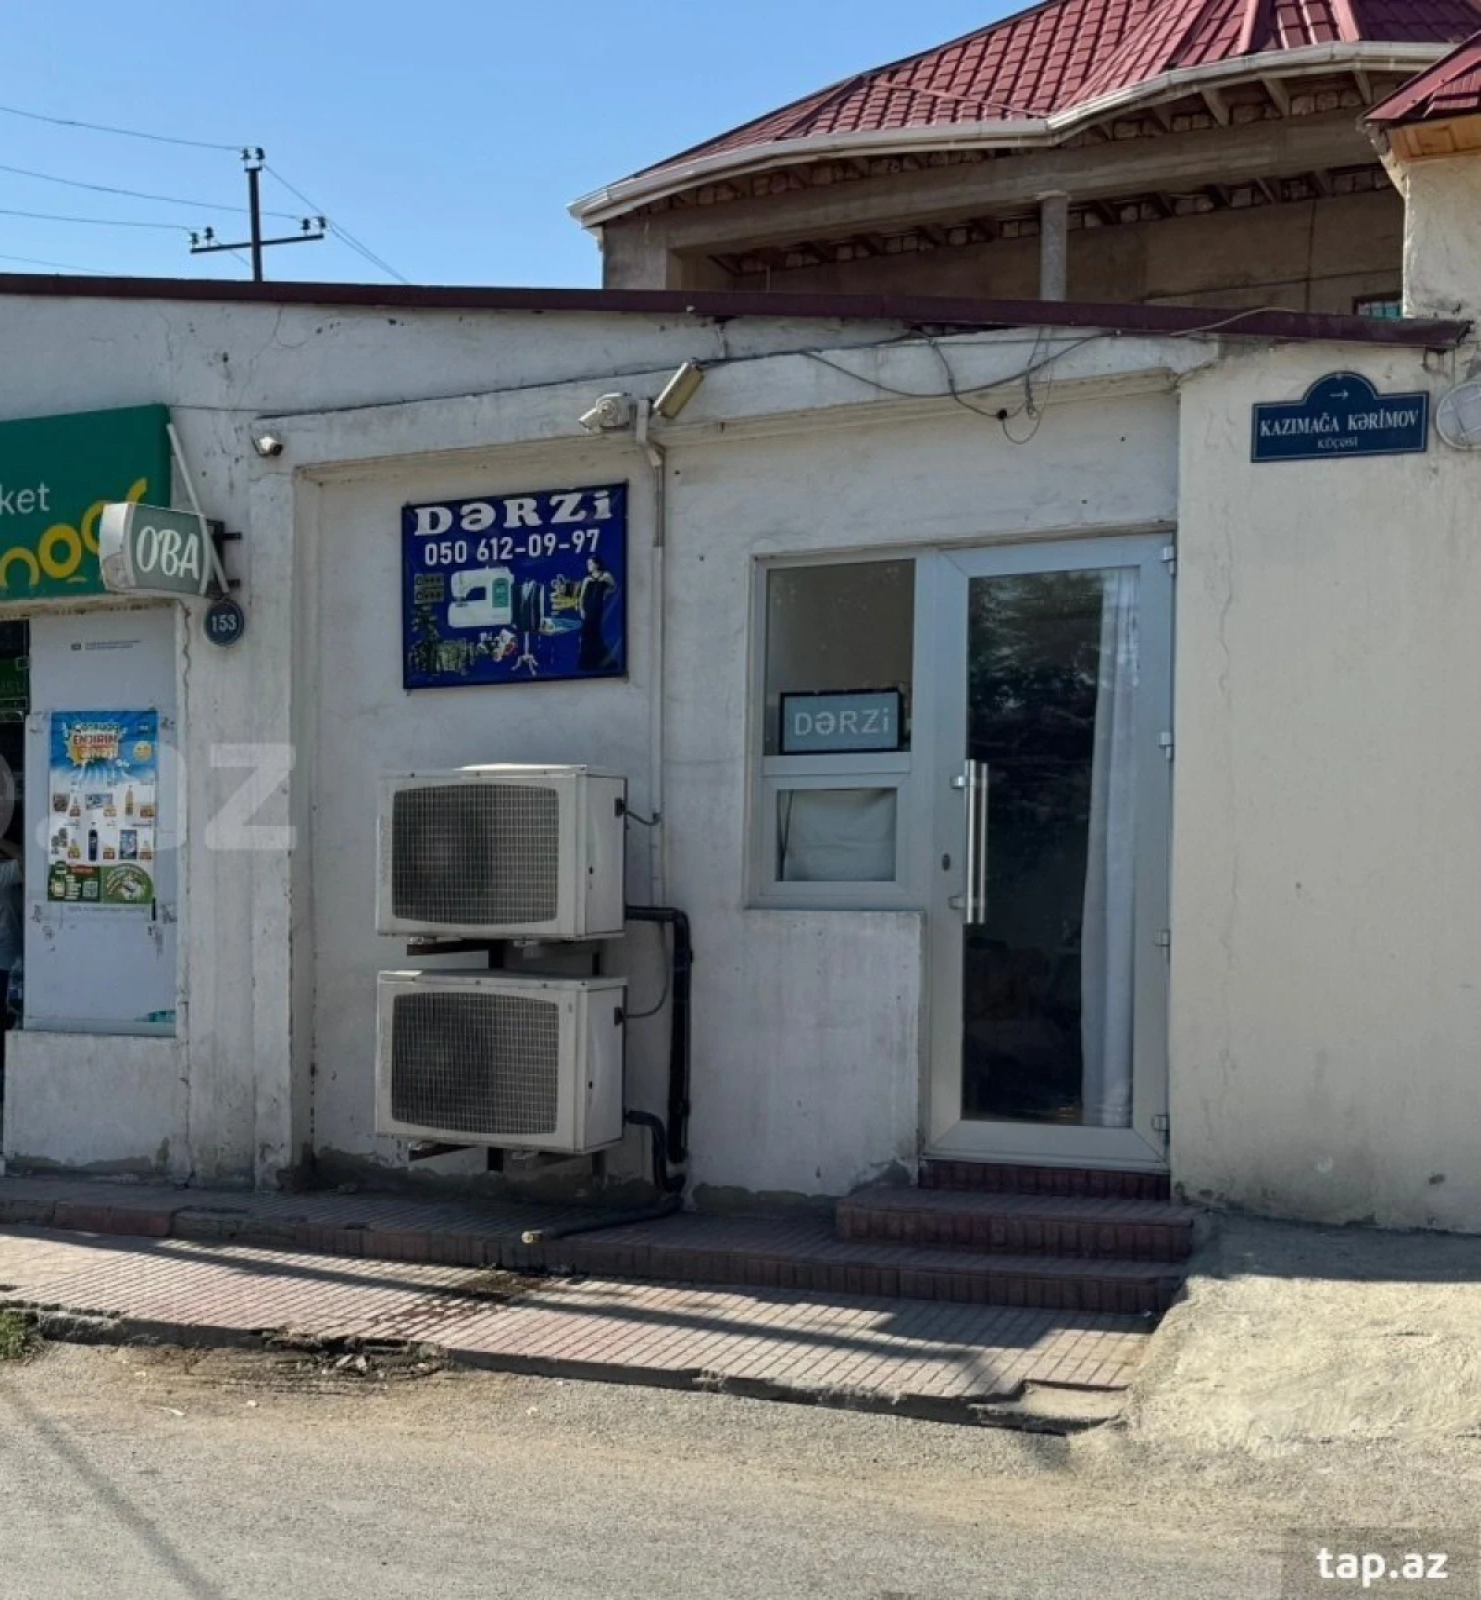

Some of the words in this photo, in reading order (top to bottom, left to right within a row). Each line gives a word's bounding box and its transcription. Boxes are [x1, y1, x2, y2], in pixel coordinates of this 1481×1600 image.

[1260, 412, 1339, 437] KAZIMAĞA
[1348, 408, 1419, 431] KƏRİMOV
[136, 525, 200, 581] OBA
[424, 541, 467, 566] 050
[476, 528, 601, 562] 612-09-97
[211, 613, 238, 632] 153
